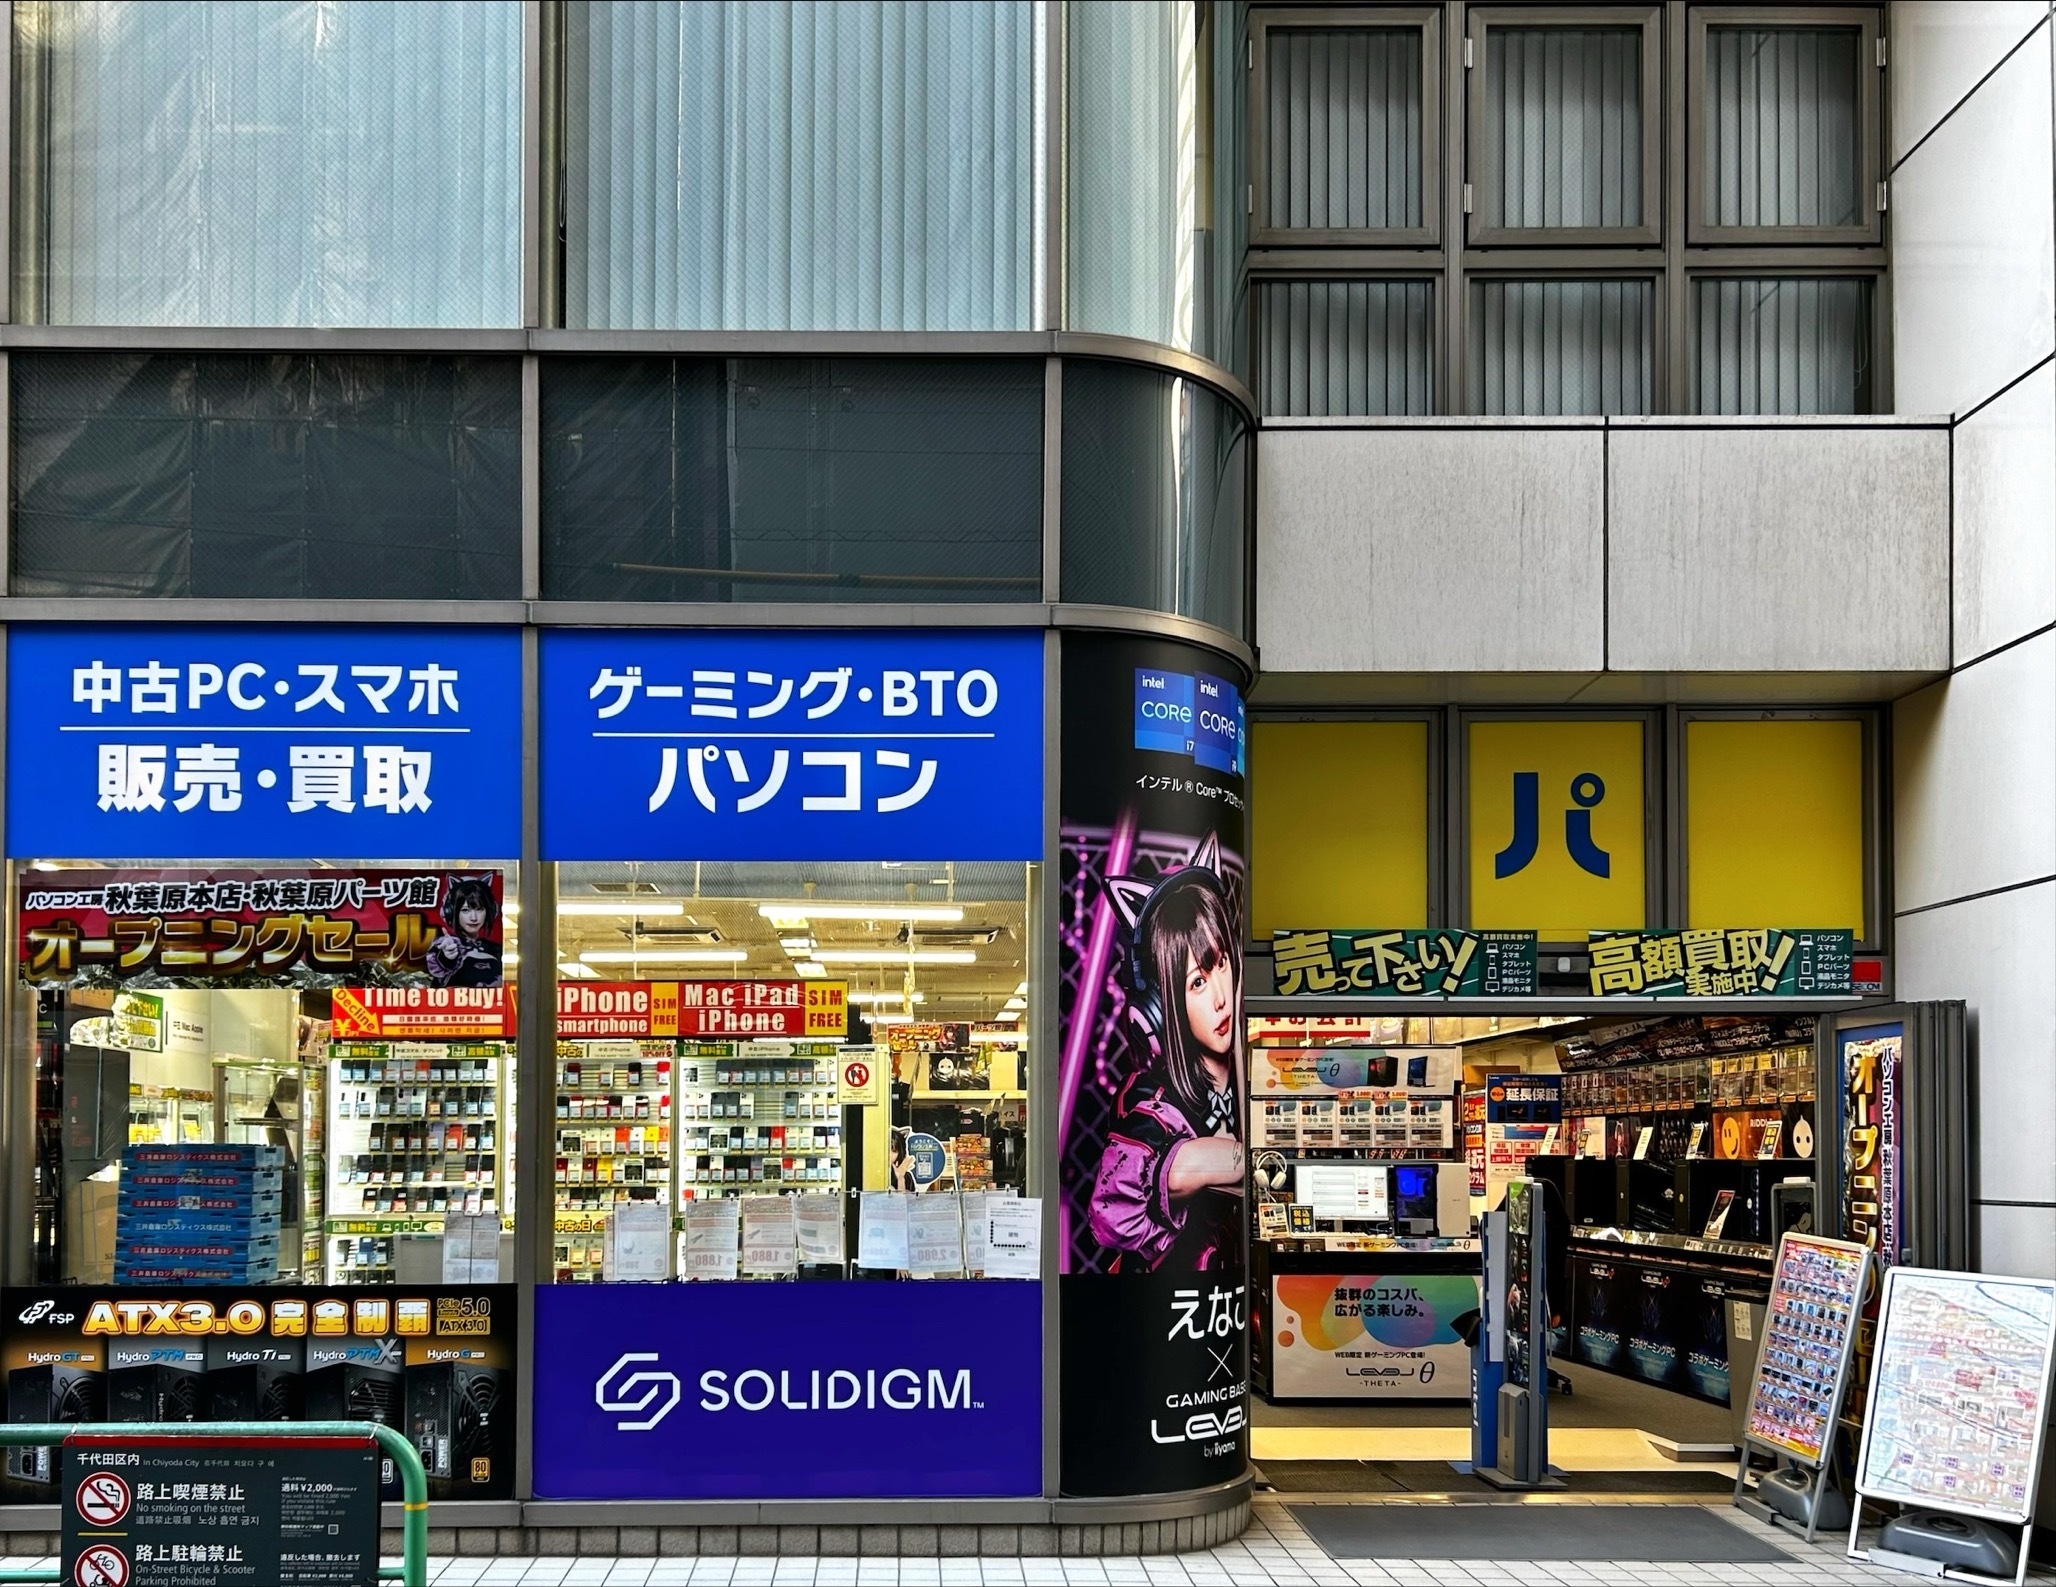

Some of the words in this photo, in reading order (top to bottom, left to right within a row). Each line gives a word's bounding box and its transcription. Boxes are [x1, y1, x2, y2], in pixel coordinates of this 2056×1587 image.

[1142, 675, 1165, 690] intel
[1200, 680, 1218, 698] intel
[589, 666, 998, 720] ゲーミング・BTO
[1186, 740, 1195, 751] i7
[96, 742, 433, 814] 販売・買取
[648, 744, 938, 814] パソコン
[28, 893, 104, 908] パソコン工房
[27, 914, 437, 971] オープニングセール
[1502, 960, 1531, 968] タブレット
[1817, 953, 1850, 961] タブレット
[1684, 969, 1757, 996] 実施中
[364, 988, 421, 1008] Time
[427, 988, 448, 1008] to
[453, 988, 503, 1010] Buy!
[557, 986, 648, 1014] iPhone
[685, 984, 735, 1007] Mac
[743, 983, 799, 1006] iPad
[808, 989, 842, 1006] SIM
[335, 989, 376, 1032] Decline
[653, 998, 677, 1010] SIM
[557, 1017, 648, 1035] smartphone
[654, 1014, 677, 1025] FREE
[698, 1009, 786, 1032] iPhone
[809, 1012, 842, 1028] FREE
[1506, 1087, 1559, 1102] 延長保証
[555, 1220, 592, 1232] 中古の日
[460, 1297, 490, 1317] 5.0
[49, 1314, 75, 1324] FSP
[82, 1300, 264, 1335] ATX3.0
[700, 1368, 971, 1411] SOLIDIGM
[1166, 1387, 1228, 1409] GAMING
[76, 1452, 140, 1466] 千代田区内
[152, 1458, 183, 1468] Chiyoda
[184, 1458, 200, 1468] City
[1203, 1445, 1214, 1458] by
[475, 1461, 487, 1473] 80
[137, 1483, 246, 1501] 路上喫煙禁止
[301, 1483, 333, 1493] ¥2,000
[136, 1503, 149, 1513] No
[151, 1503, 188, 1515] smoking
[190, 1505, 201, 1513] on
[203, 1503, 218, 1513] the
[219, 1503, 246, 1513] street
[198, 1515, 217, 1526] 노상
[220, 1515, 238, 1526] 흡연
[241, 1515, 260, 1526] 금지
[135, 1544, 244, 1563] 路上駐輪禁止
[136, 1564, 179, 1575] On-Street
[180, 1564, 211, 1576] Bicycle
[213, 1565, 220, 1575] &
[222, 1564, 256, 1575] Scooter
[136, 1576, 170, 1587] Parking
[171, 1576, 217, 1586] Prohibited
